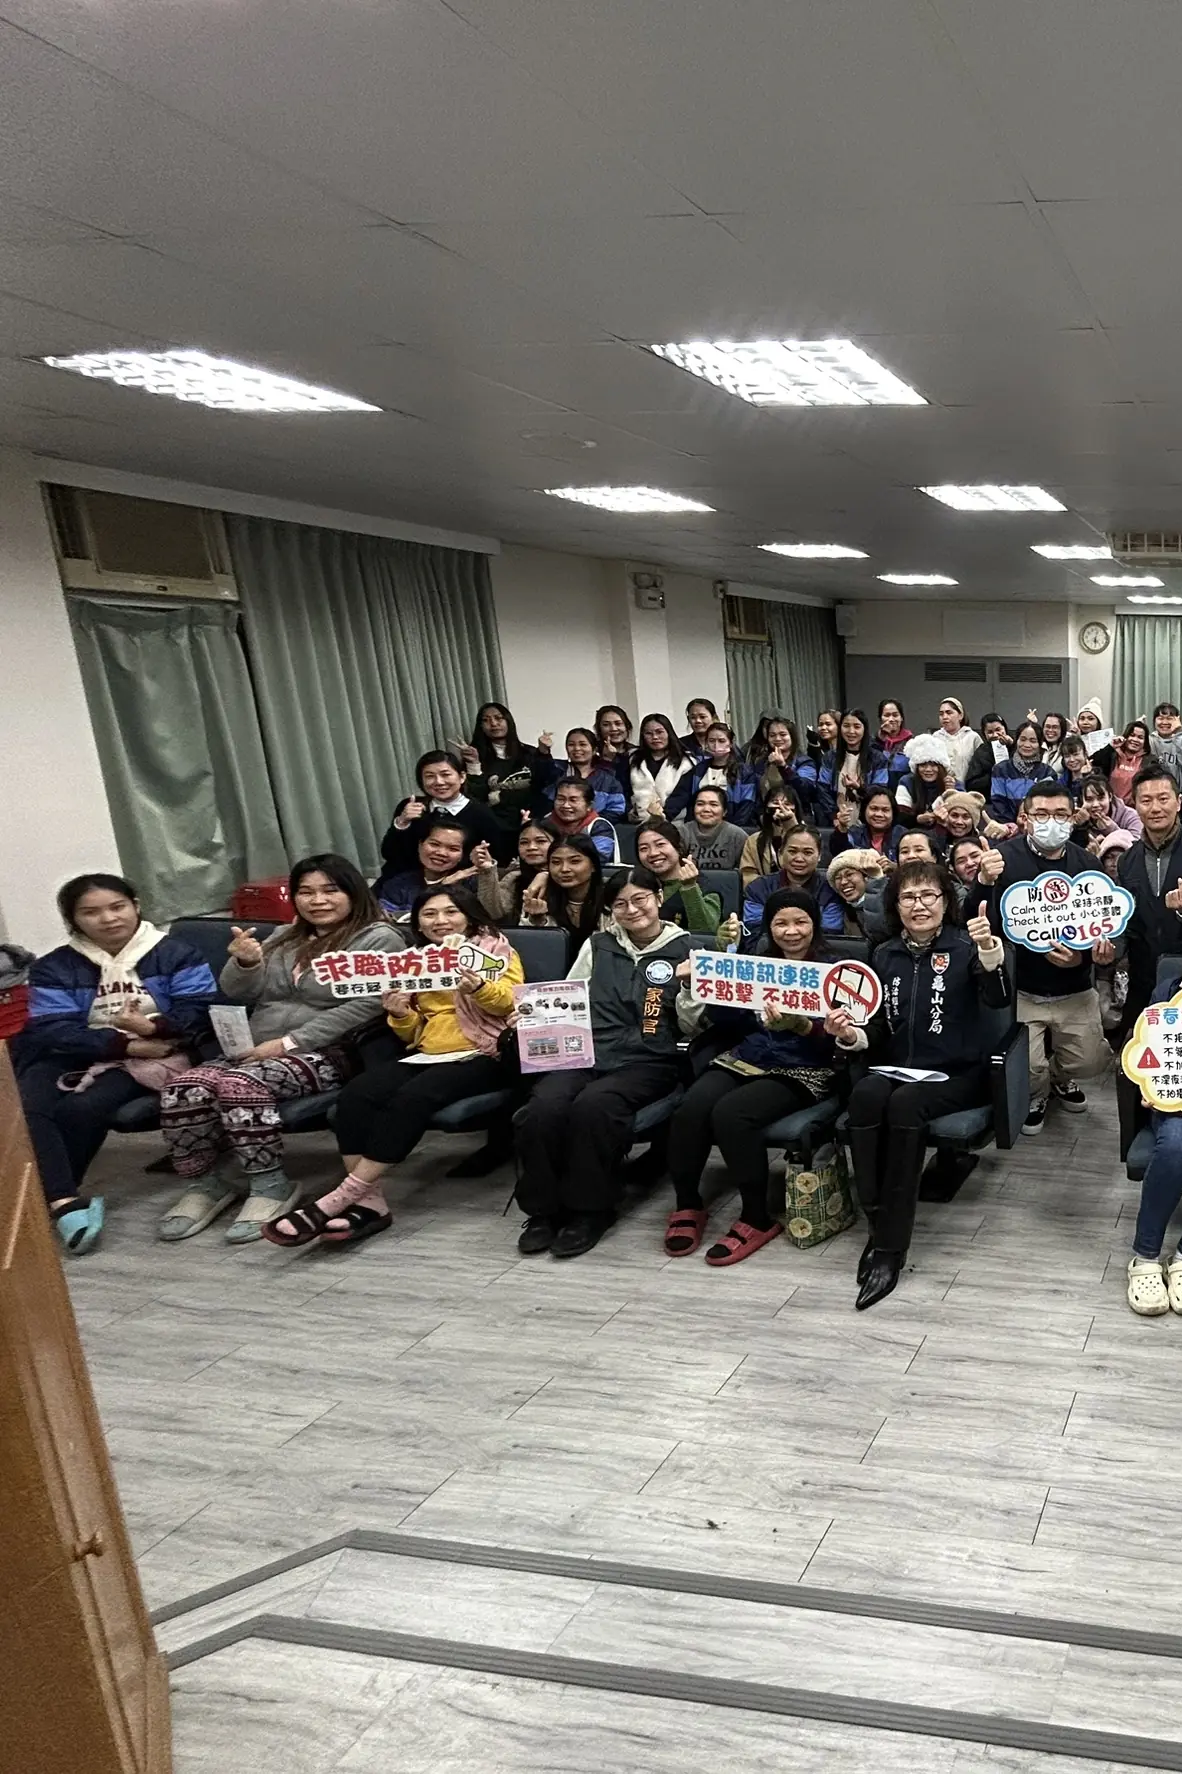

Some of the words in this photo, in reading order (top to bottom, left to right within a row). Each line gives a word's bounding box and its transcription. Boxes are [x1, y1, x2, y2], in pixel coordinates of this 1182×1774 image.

[1075, 882, 1095, 897] 3C
[1006, 915, 1039, 928] Check
[1043, 914, 1053, 924] it
[1056, 911, 1076, 922] out
[1080, 906, 1122, 919] 小心查證
[1011, 905, 1036, 916] Calm
[1040, 902, 1068, 913] down
[1071, 895, 1114, 909] 保持冷靜
[1026, 927, 1060, 942] Call
[1076, 917, 1114, 941] 165
[315, 947, 459, 983] 求職防詐
[695, 955, 820, 989] 不明簡訊連結
[334, 981, 382, 996] 要存疑
[696, 978, 754, 1004] 不點擊
[762, 987, 821, 1012] 不填輸
[642, 987, 664, 1034] 家防官
